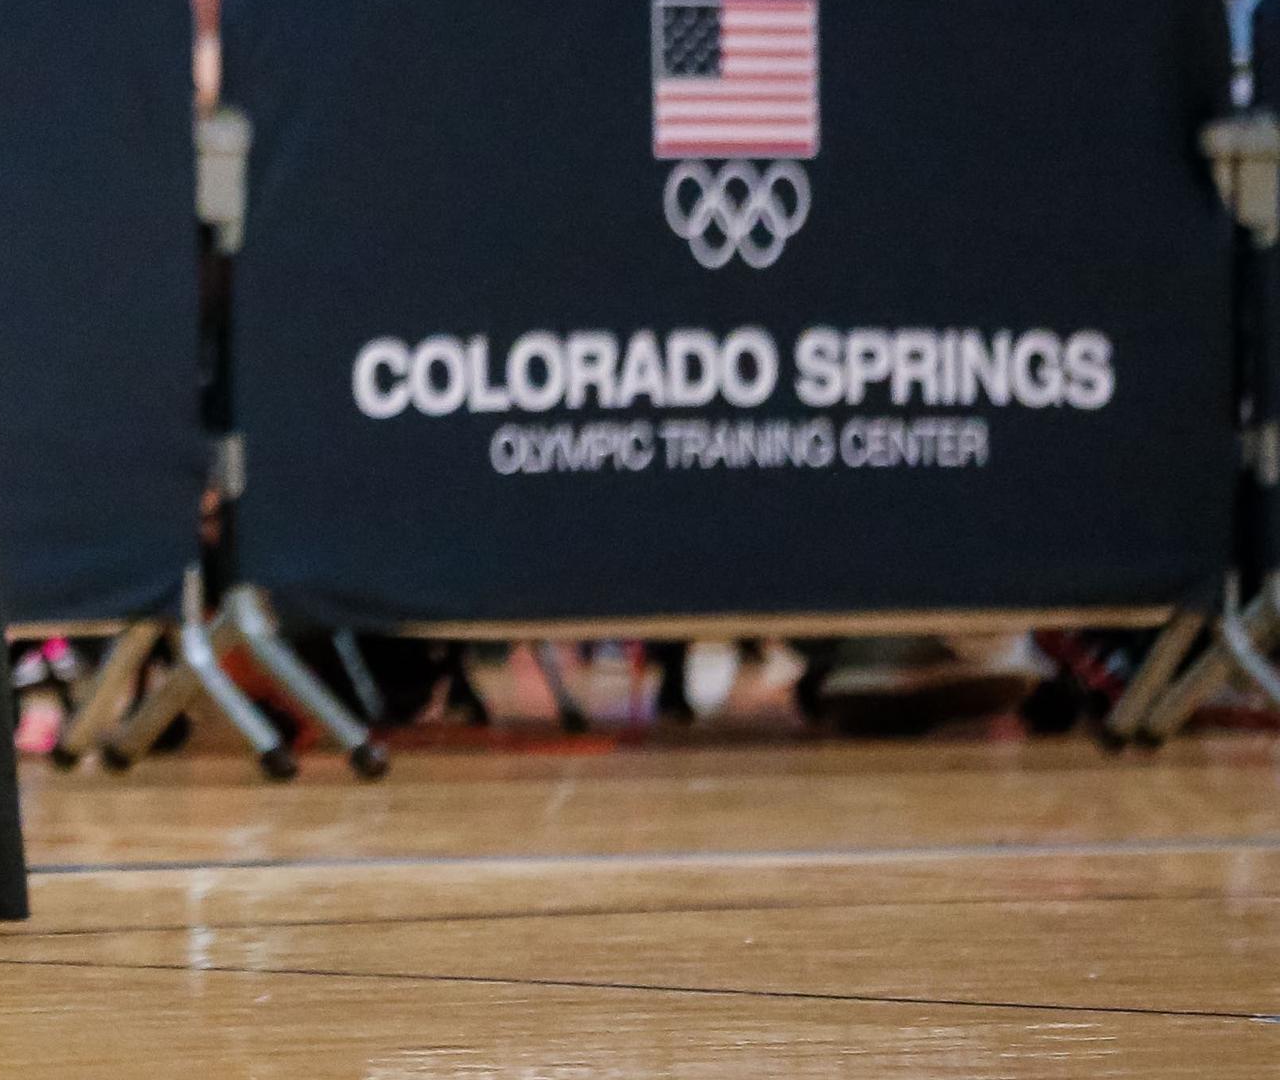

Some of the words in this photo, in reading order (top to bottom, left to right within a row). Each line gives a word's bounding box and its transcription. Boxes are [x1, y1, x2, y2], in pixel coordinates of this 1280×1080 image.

[351, 328, 780, 419] COLORADO
[794, 326, 1116, 410] SPRINGS
[488, 421, 656, 475] OLYMPIC
[659, 418, 837, 470] TRAINING
[840, 416, 991, 469] CENTER
